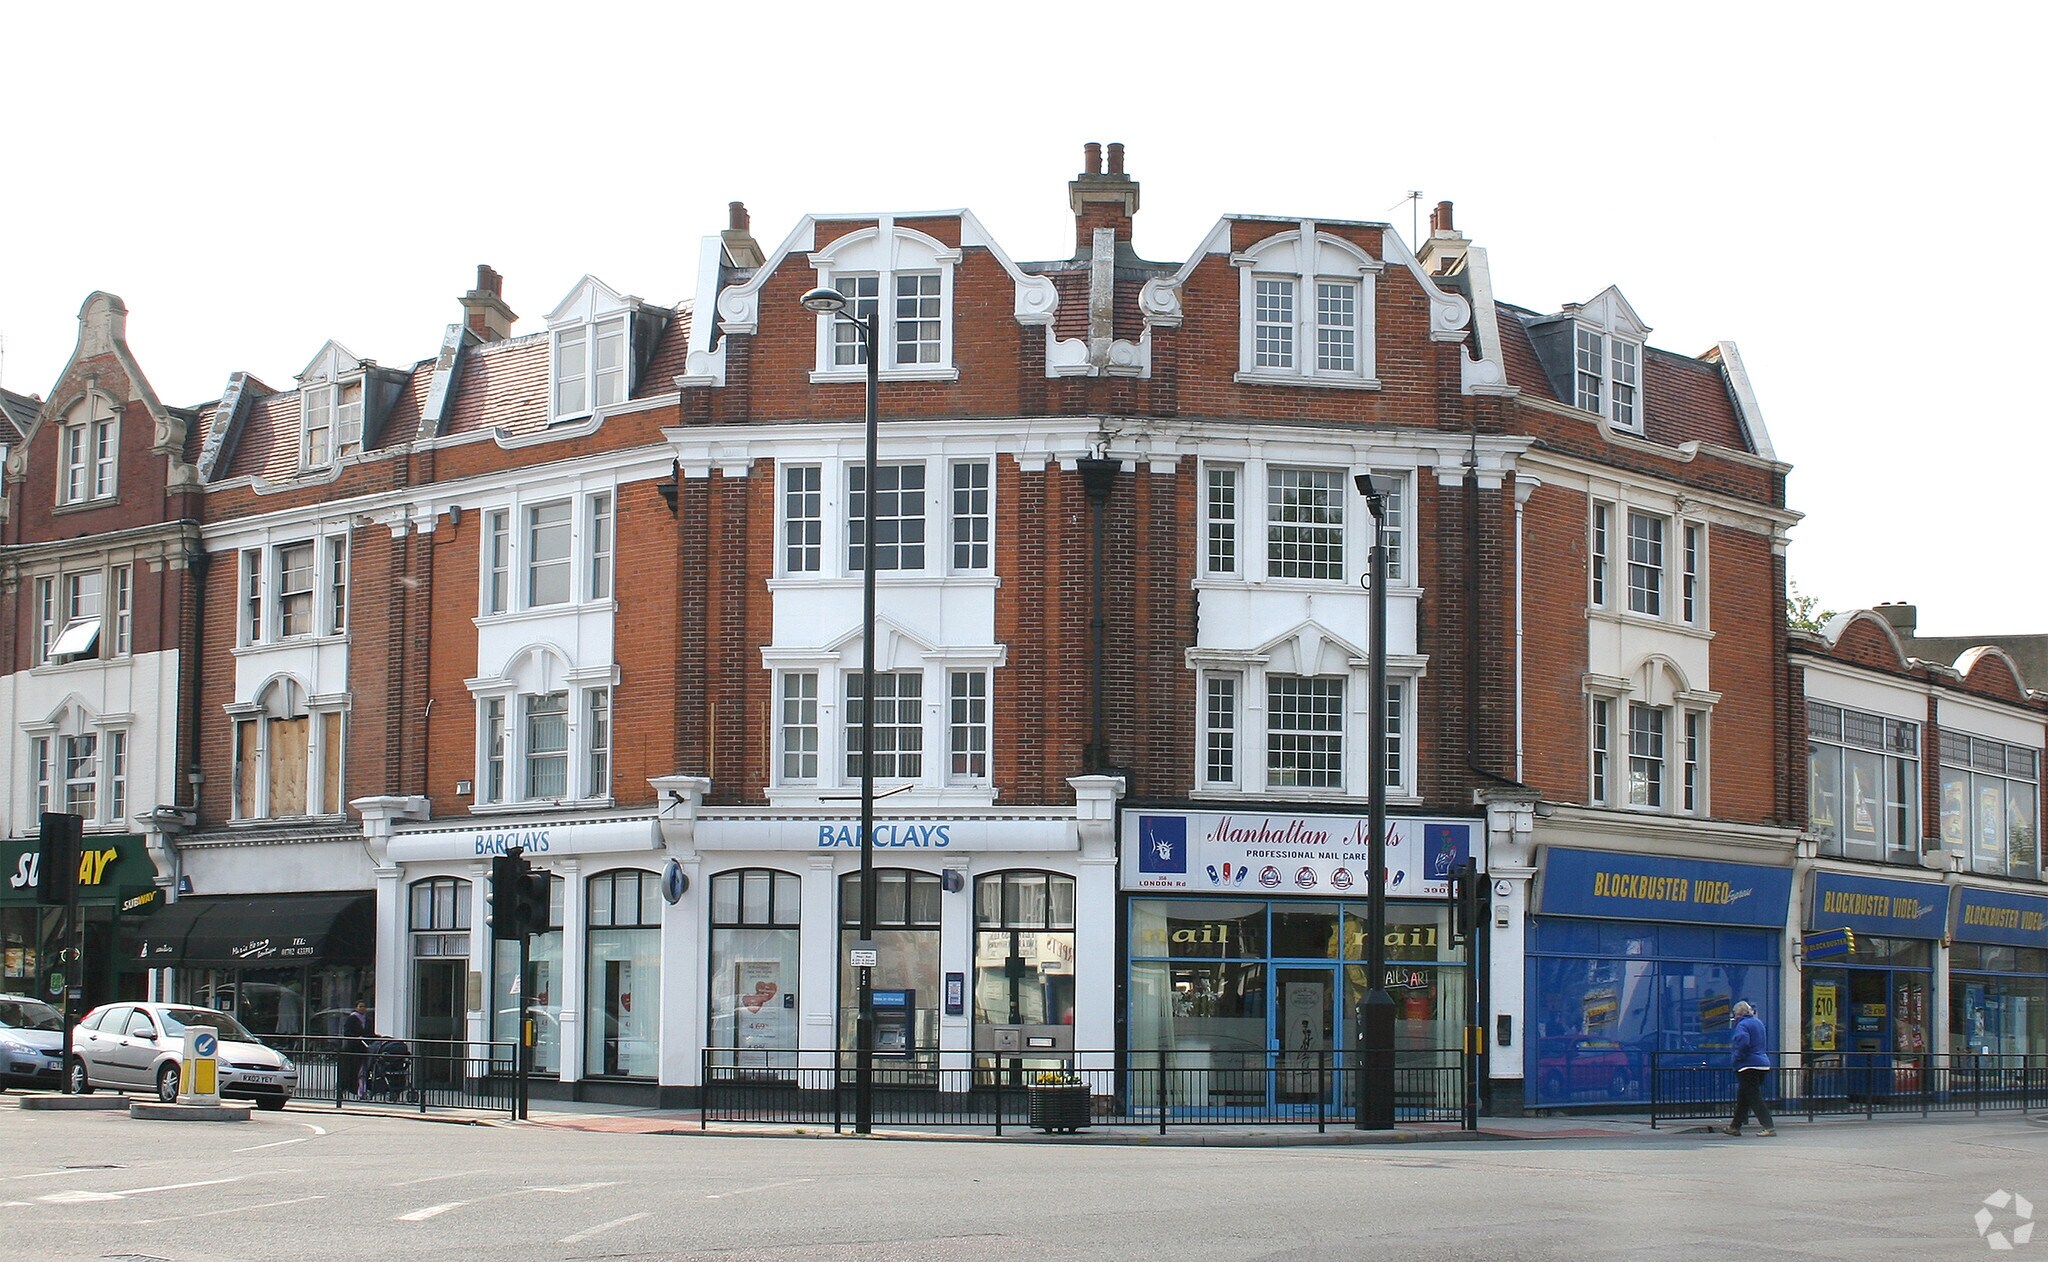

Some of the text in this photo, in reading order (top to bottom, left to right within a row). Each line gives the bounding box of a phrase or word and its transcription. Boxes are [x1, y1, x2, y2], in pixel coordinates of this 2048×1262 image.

[1206, 816, 1331, 845] Manhattan
[475, 831, 550, 855] BARCLAYS
[1246, 850, 1367, 861] PROFESSIONAL NAIL CARE
[1594, 872, 1688, 902] BLOCKBUSTER
[1693, 880, 1730, 905] VIDEO
[122, 890, 157, 911] SUBWAY
[1824, 891, 1889, 917] BLOCKBUSTER
[1892, 897, 1918, 920] VIDEO
[1964, 904, 2019, 929] BLOCKBUSTER
[2020, 910, 2044, 931] VIDEO
[1143, 925, 1229, 944] nail
[1809, 938, 1847, 952] BLOCKBUSTER
[1410, 970, 1429, 986] ART
[1815, 997, 1833, 1016] £10
